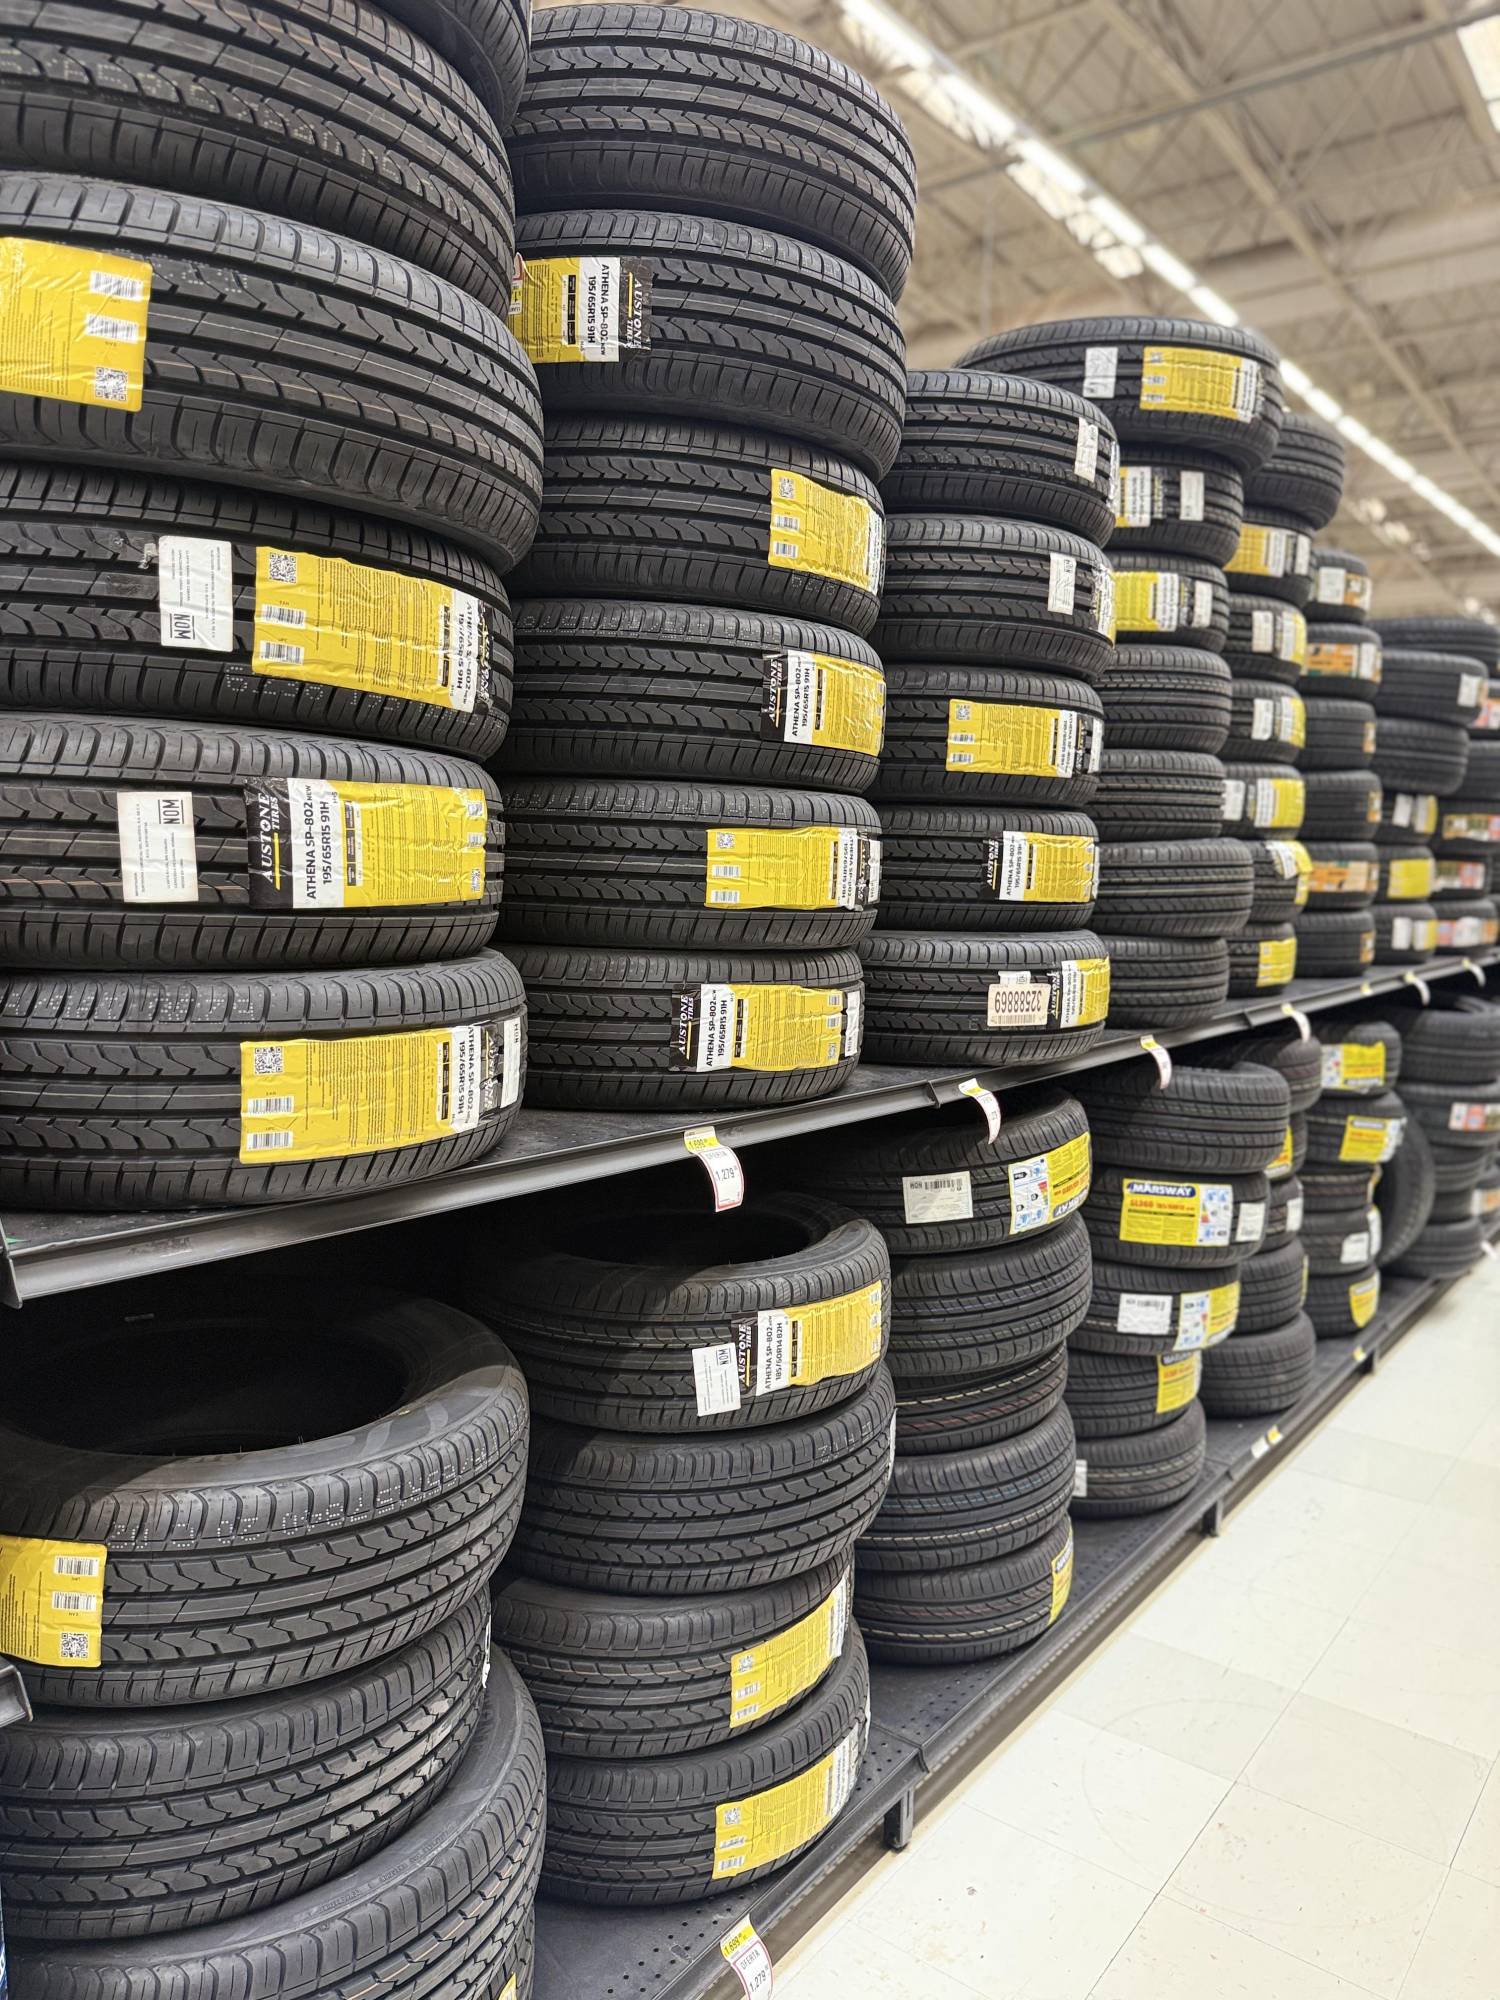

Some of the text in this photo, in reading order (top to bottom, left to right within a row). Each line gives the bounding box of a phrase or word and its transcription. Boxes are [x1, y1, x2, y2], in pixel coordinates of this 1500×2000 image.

[600, 263, 610, 304] ATHENA
[587, 275, 597, 344] 195/65R15 91H
[600, 305, 609, 341] SP-802
[173, 613, 192, 640] NOM
[769, 659, 778, 722] AUSTONE
[802, 685, 810, 727] 195/65R15
[792, 701, 800, 736] ATHENA
[163, 800, 181, 825] NOM
[270, 796, 281, 830] TIRES
[304, 802, 316, 847] SP-802
[259, 793, 274, 883] AUSTONE
[320, 801, 333, 885] 195/65R15 91H
[306, 849, 317, 899] ATHENA
[987, 839, 995, 886] AUSTONE
[708, 1001, 717, 1032] SP-802
[995, 991, 1042, 1013] 32588869
[678, 995, 688, 1055] AUSTONE
[718, 1015, 727, 1057] 195/65R15
[706, 1033, 715, 1066] ATHENA
[457, 1095, 465, 1114] 91H
[716, 1168, 735, 1182] 1,279
[1132, 1182, 1193, 1197] MARSWAY
[718, 1348, 729, 1366] NOM
[739, 1323, 747, 1383] AUSTONE
[740, 1949, 760, 1970] OFERTA
[749, 1970, 767, 1992] 1,279
